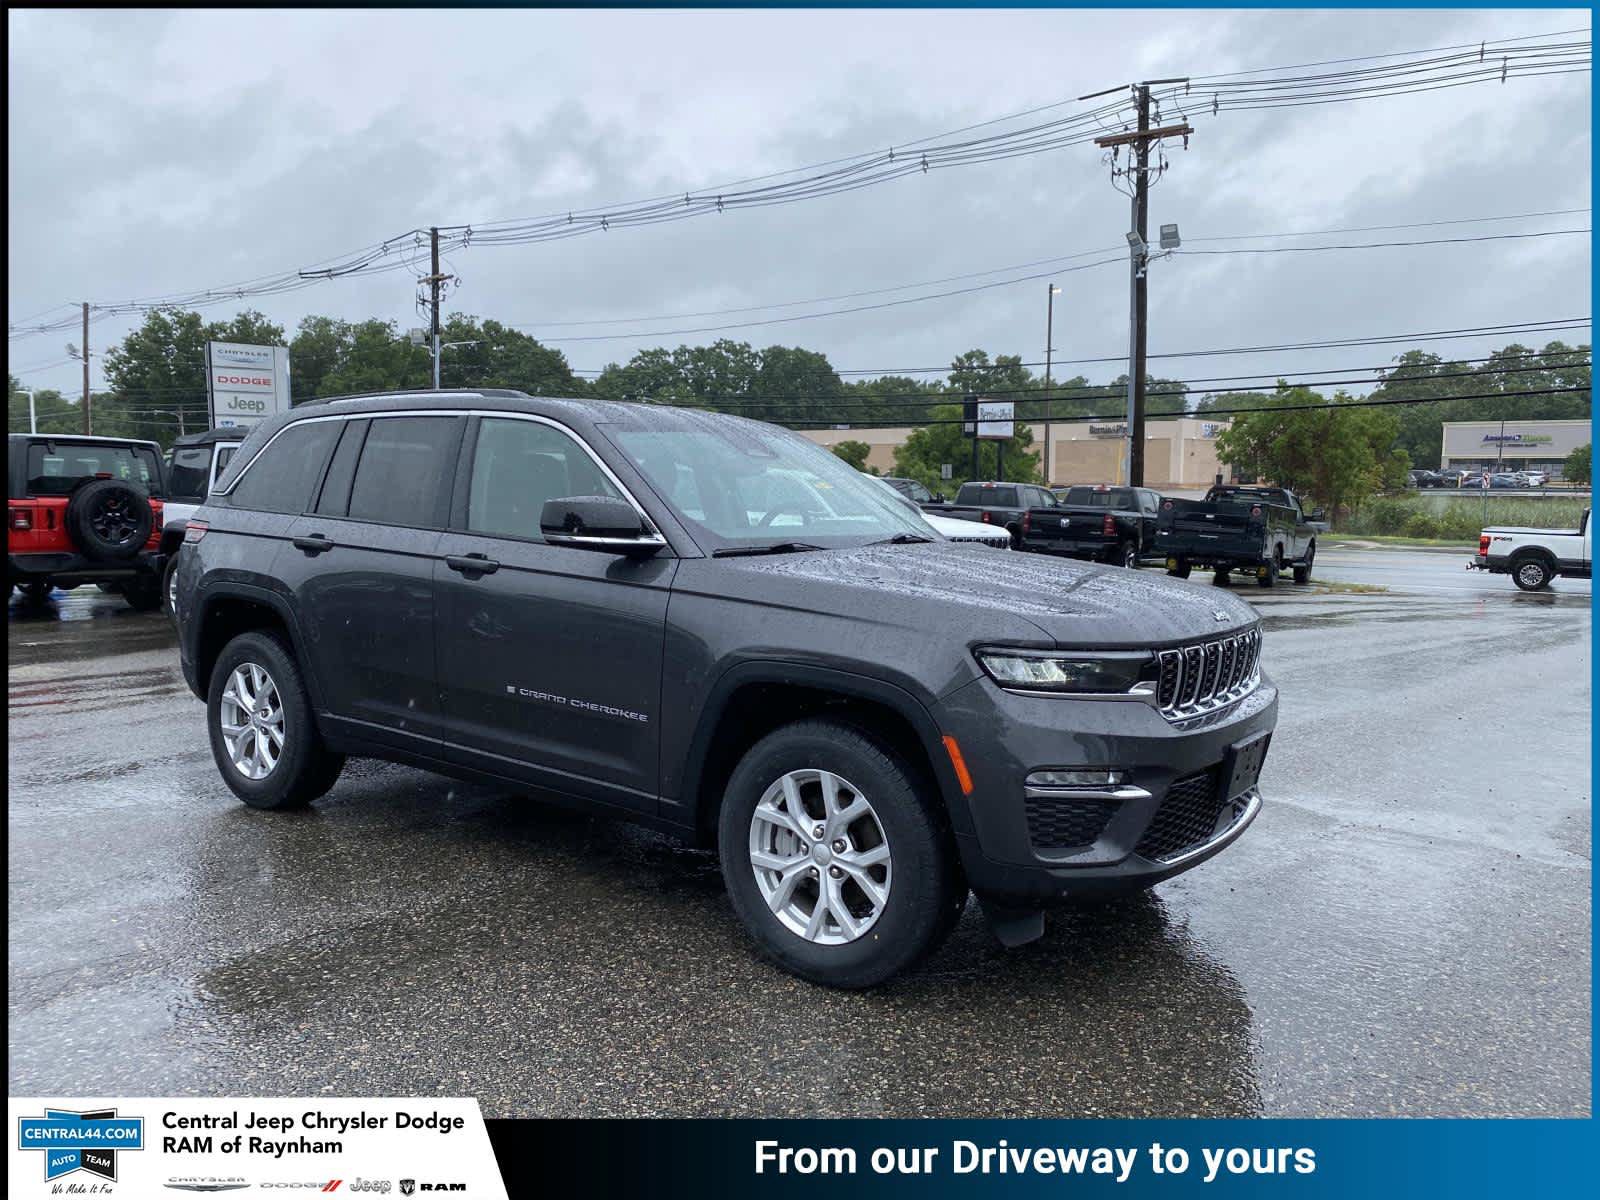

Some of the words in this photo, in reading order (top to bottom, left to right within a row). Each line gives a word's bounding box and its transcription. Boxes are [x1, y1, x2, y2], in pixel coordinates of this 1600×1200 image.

[217, 376, 272, 385] DODGE
[228, 396, 265, 412] Jeep
[519, 688, 566, 704] GRAND
[571, 699, 648, 722] CHEROKEE
